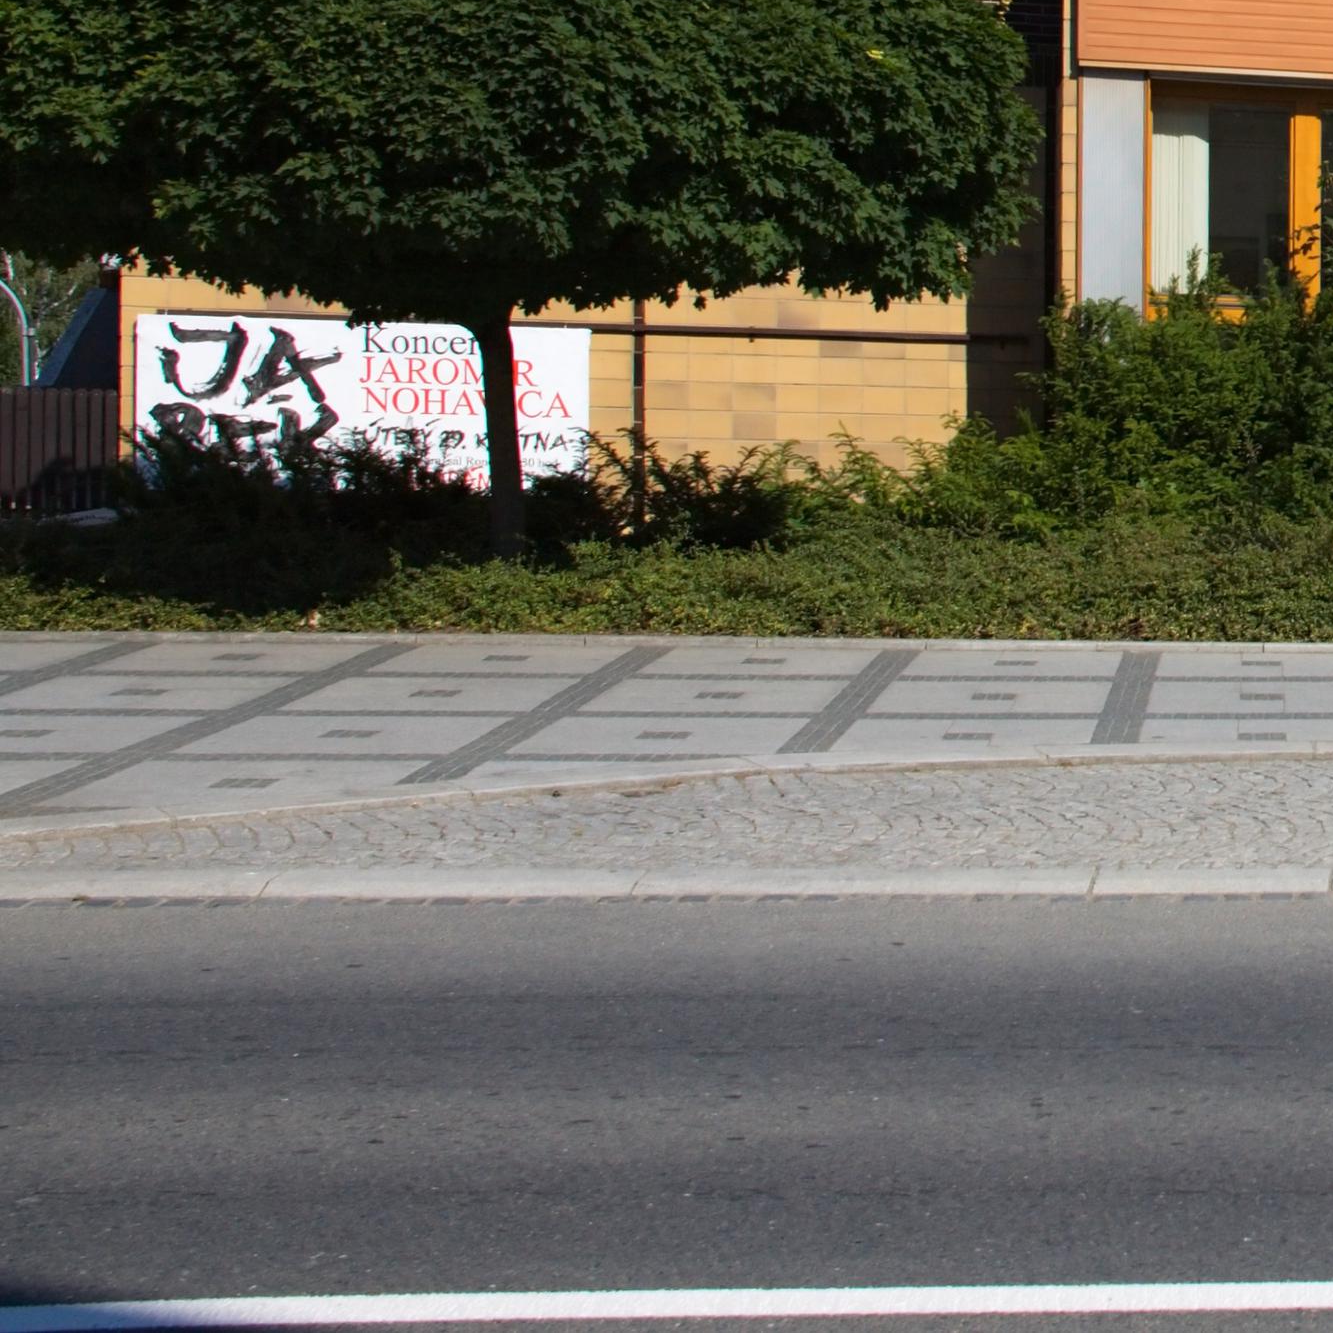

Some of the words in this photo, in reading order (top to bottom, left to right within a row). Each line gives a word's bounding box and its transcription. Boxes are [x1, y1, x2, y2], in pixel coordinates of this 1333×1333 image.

[361, 326, 480, 356] Koncer
[359, 356, 539, 387] JAROMR
[361, 387, 573, 418] NOHACA
[476, 425, 569, 452] KTNA
